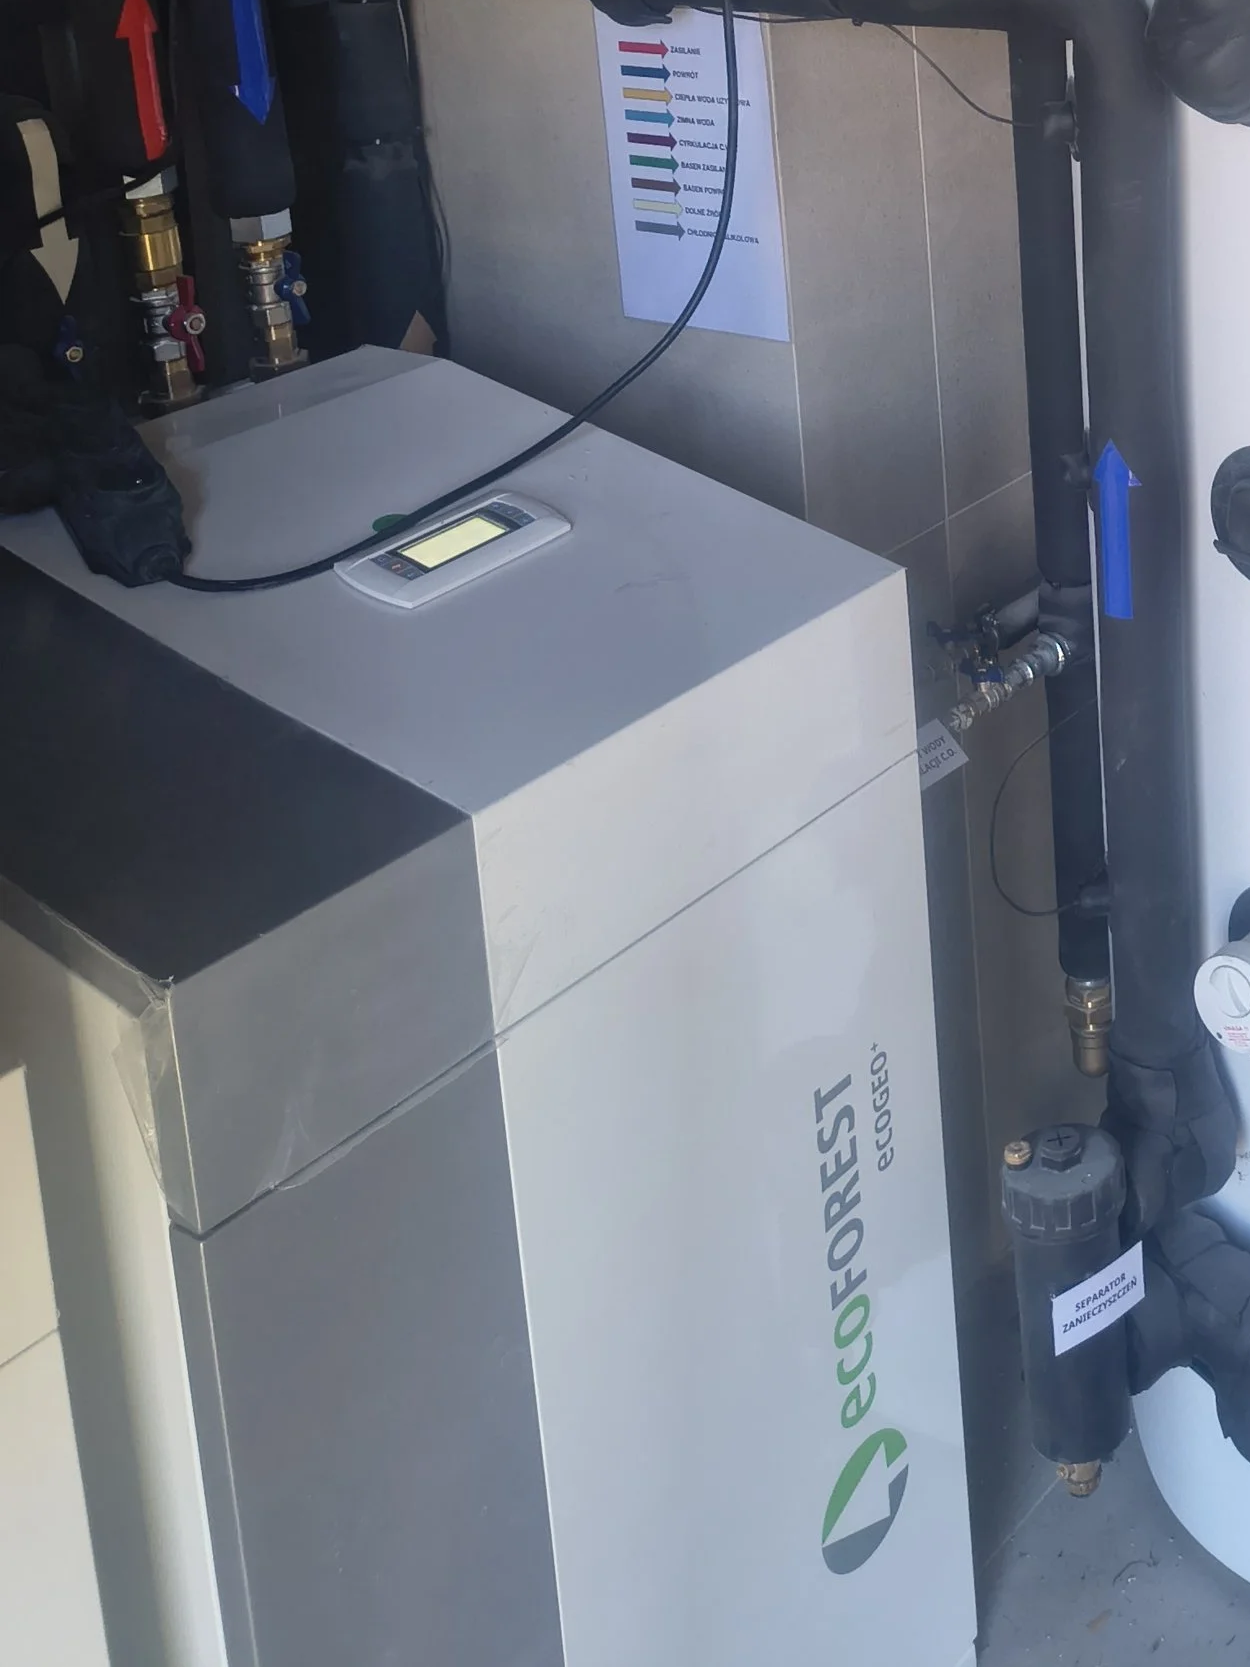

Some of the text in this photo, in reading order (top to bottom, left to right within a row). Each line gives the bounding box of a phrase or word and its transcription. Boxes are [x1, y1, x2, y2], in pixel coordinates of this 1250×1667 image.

[920, 735, 946, 755] WODY
[1062, 1275, 1138, 1334] ZANIECZYSZCZEŃ
[1075, 1272, 1126, 1313] SEPARATOR
